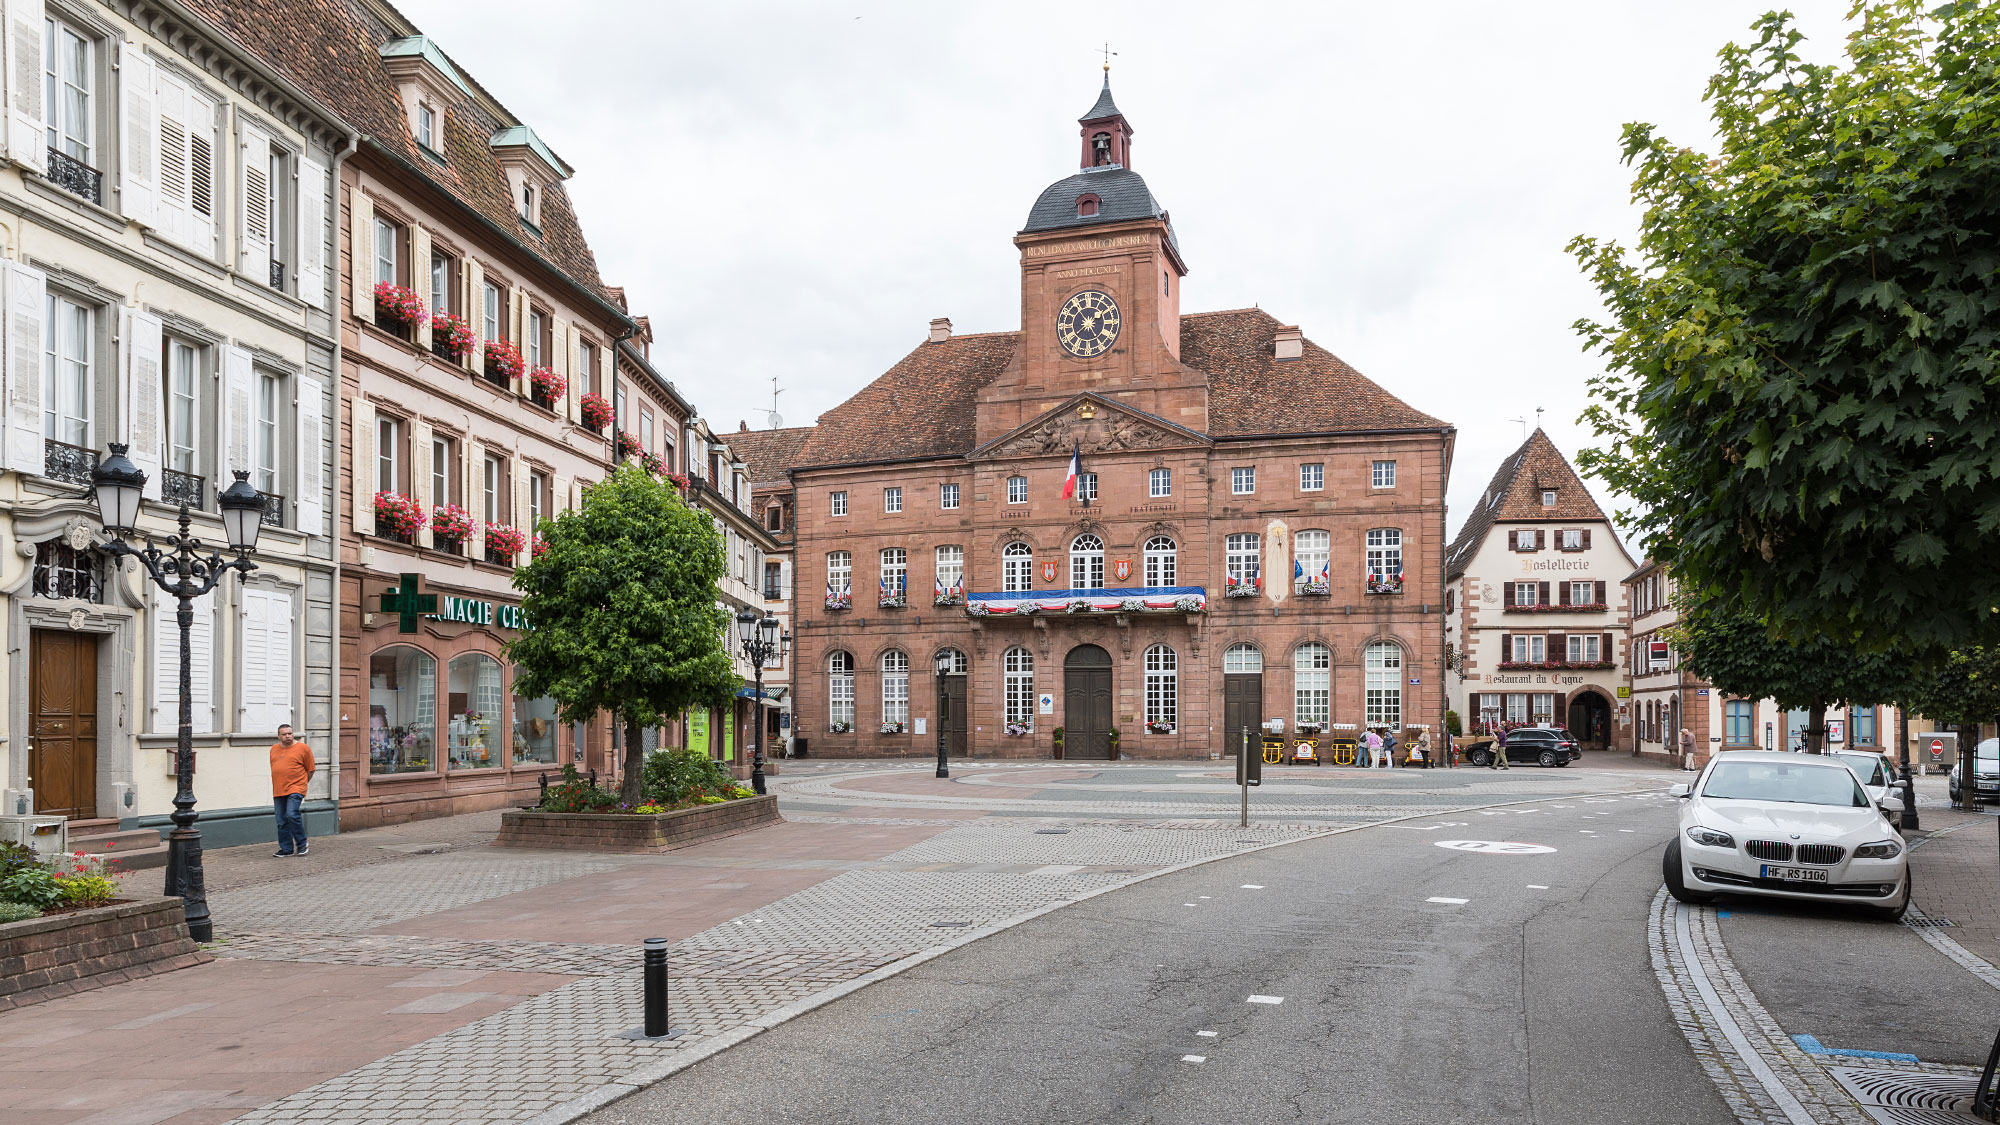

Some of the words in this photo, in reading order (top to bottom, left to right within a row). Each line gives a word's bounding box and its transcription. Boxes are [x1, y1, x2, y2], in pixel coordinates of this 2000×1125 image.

[1056, 268, 1078, 279] ANNO
[1521, 558, 1590, 573] Hostellerie
[1484, 673, 1532, 685] Restaurant
[1536, 673, 1547, 684] du
[1552, 673, 1584, 685] Cygne
[1768, 867, 1781, 877] HF
[1787, 869, 1801, 879] RS
[1801, 870, 1826, 881] 1106
